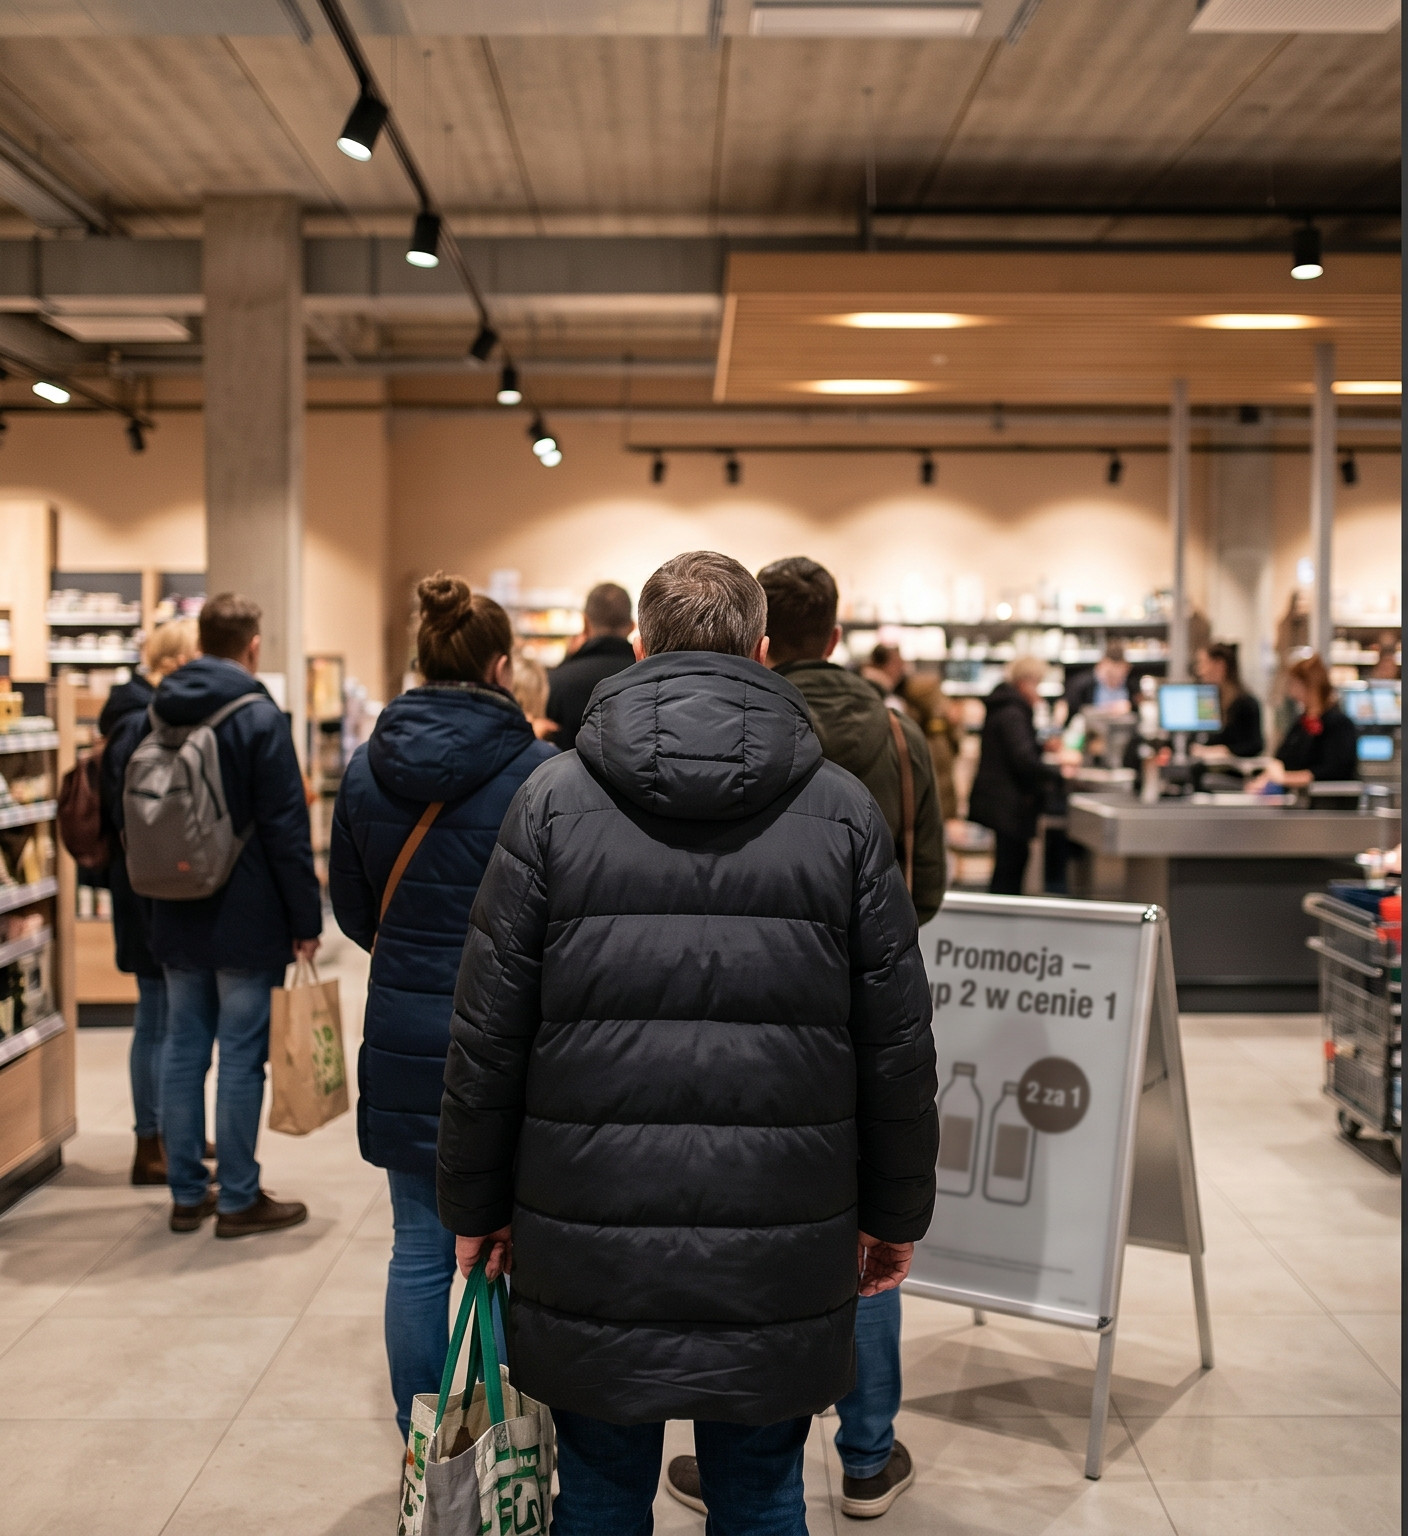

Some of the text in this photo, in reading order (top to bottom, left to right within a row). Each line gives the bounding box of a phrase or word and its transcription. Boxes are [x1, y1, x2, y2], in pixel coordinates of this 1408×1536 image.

[935, 938, 1064, 981] Promocja
[959, 979, 977, 1007] 2
[986, 987, 1009, 1010] w
[1017, 988, 1093, 1019] cenie
[1105, 991, 1117, 1021] 1
[1025, 1080, 1081, 1109] 2 za 1
